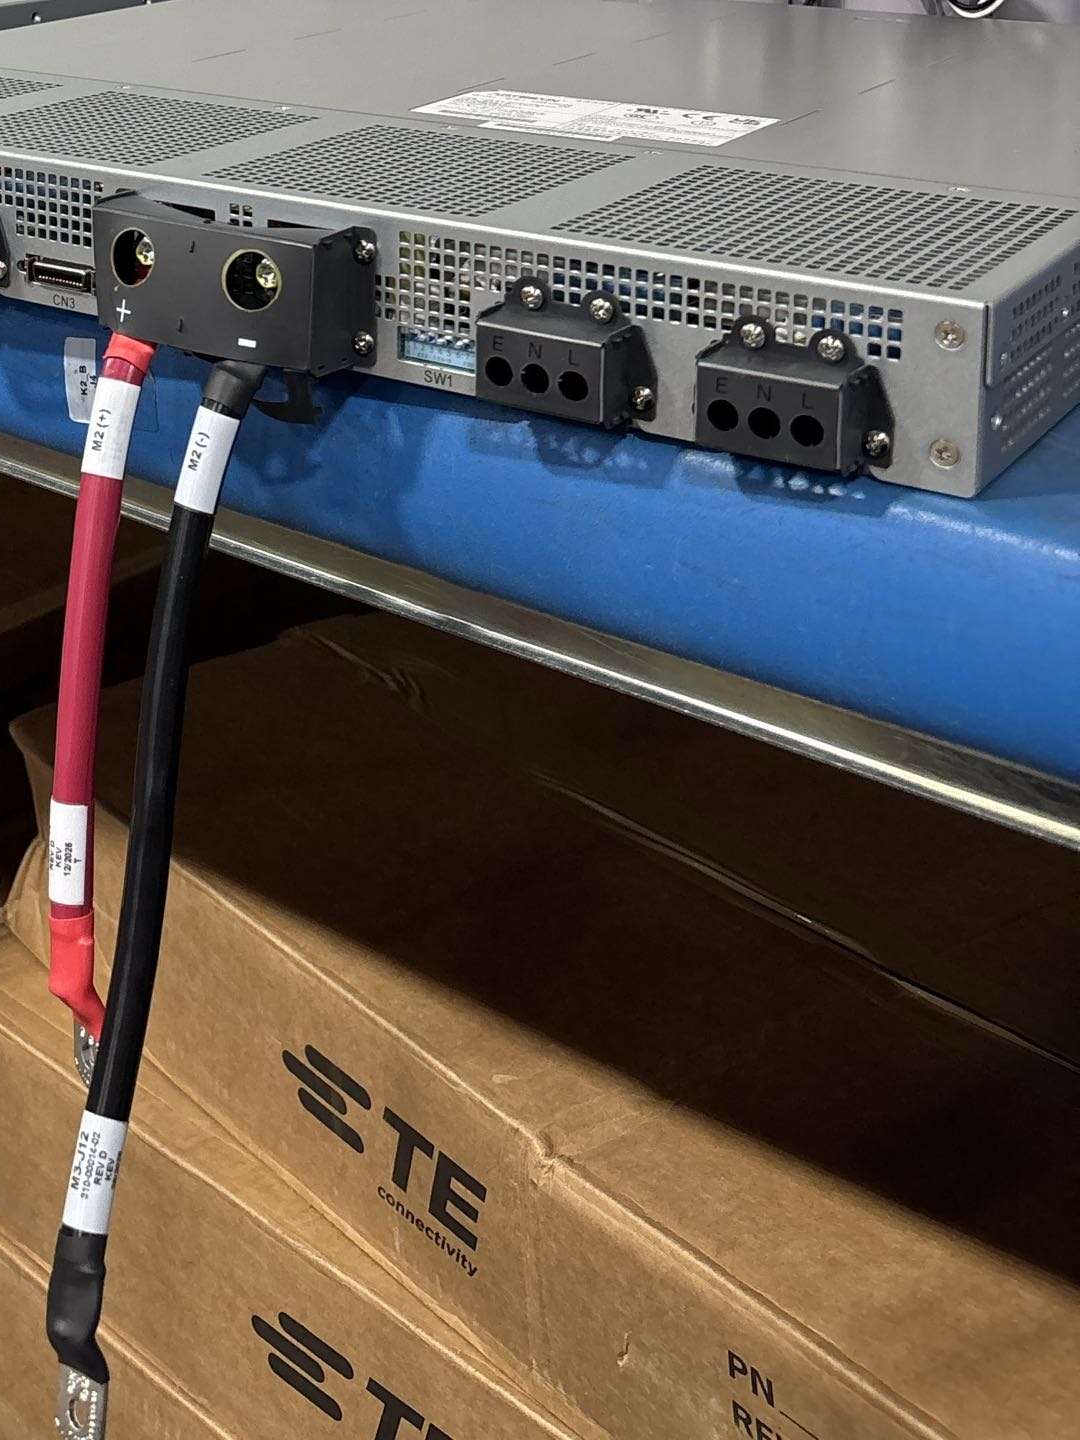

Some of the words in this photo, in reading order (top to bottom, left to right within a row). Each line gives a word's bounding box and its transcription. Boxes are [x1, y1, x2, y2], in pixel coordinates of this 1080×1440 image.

[52, 294, 76, 309] CN3
[493, 335, 504, 352] E
[528, 341, 542, 359] N
[568, 349, 580, 366] L
[79, 364, 88, 397] K2_B
[423, 369, 453, 387] SW1
[715, 376, 728, 394] E
[756, 383, 771, 402] N
[802, 391, 814, 410] L
[55, 847, 63, 868] KEV
[70, 1131, 89, 1190] M3-J12
[99, 1150, 108, 1160] D
[105, 1158, 115, 1182] KEV
[94, 1161, 106, 1185] REV
[382, 1105, 488, 1252] TE
[377, 1185, 478, 1277] connectivity
[728, 1349, 775, 1408] PN
[732, 1399, 783, 1440] RE
